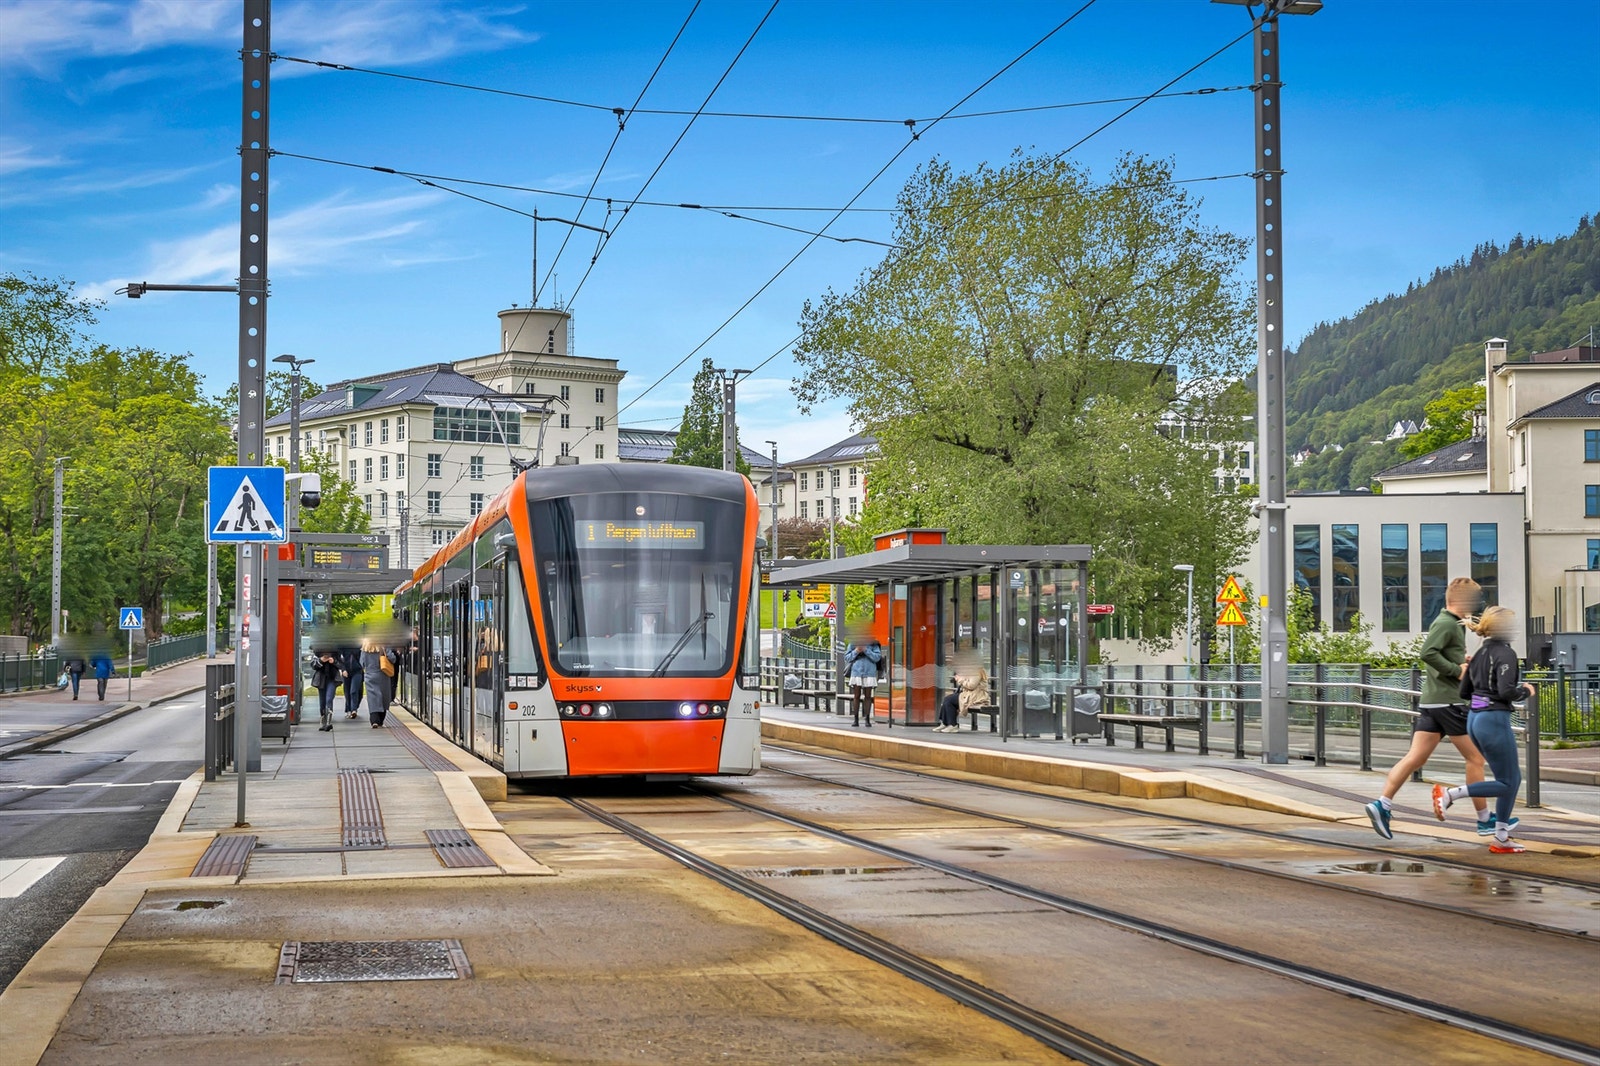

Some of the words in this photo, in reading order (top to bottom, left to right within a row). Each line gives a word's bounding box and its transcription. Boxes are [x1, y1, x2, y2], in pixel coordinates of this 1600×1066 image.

[588, 524, 595, 541] 1
[566, 684, 594, 693] skyss
[522, 705, 536, 716] 202
[743, 703, 752, 714] 202
